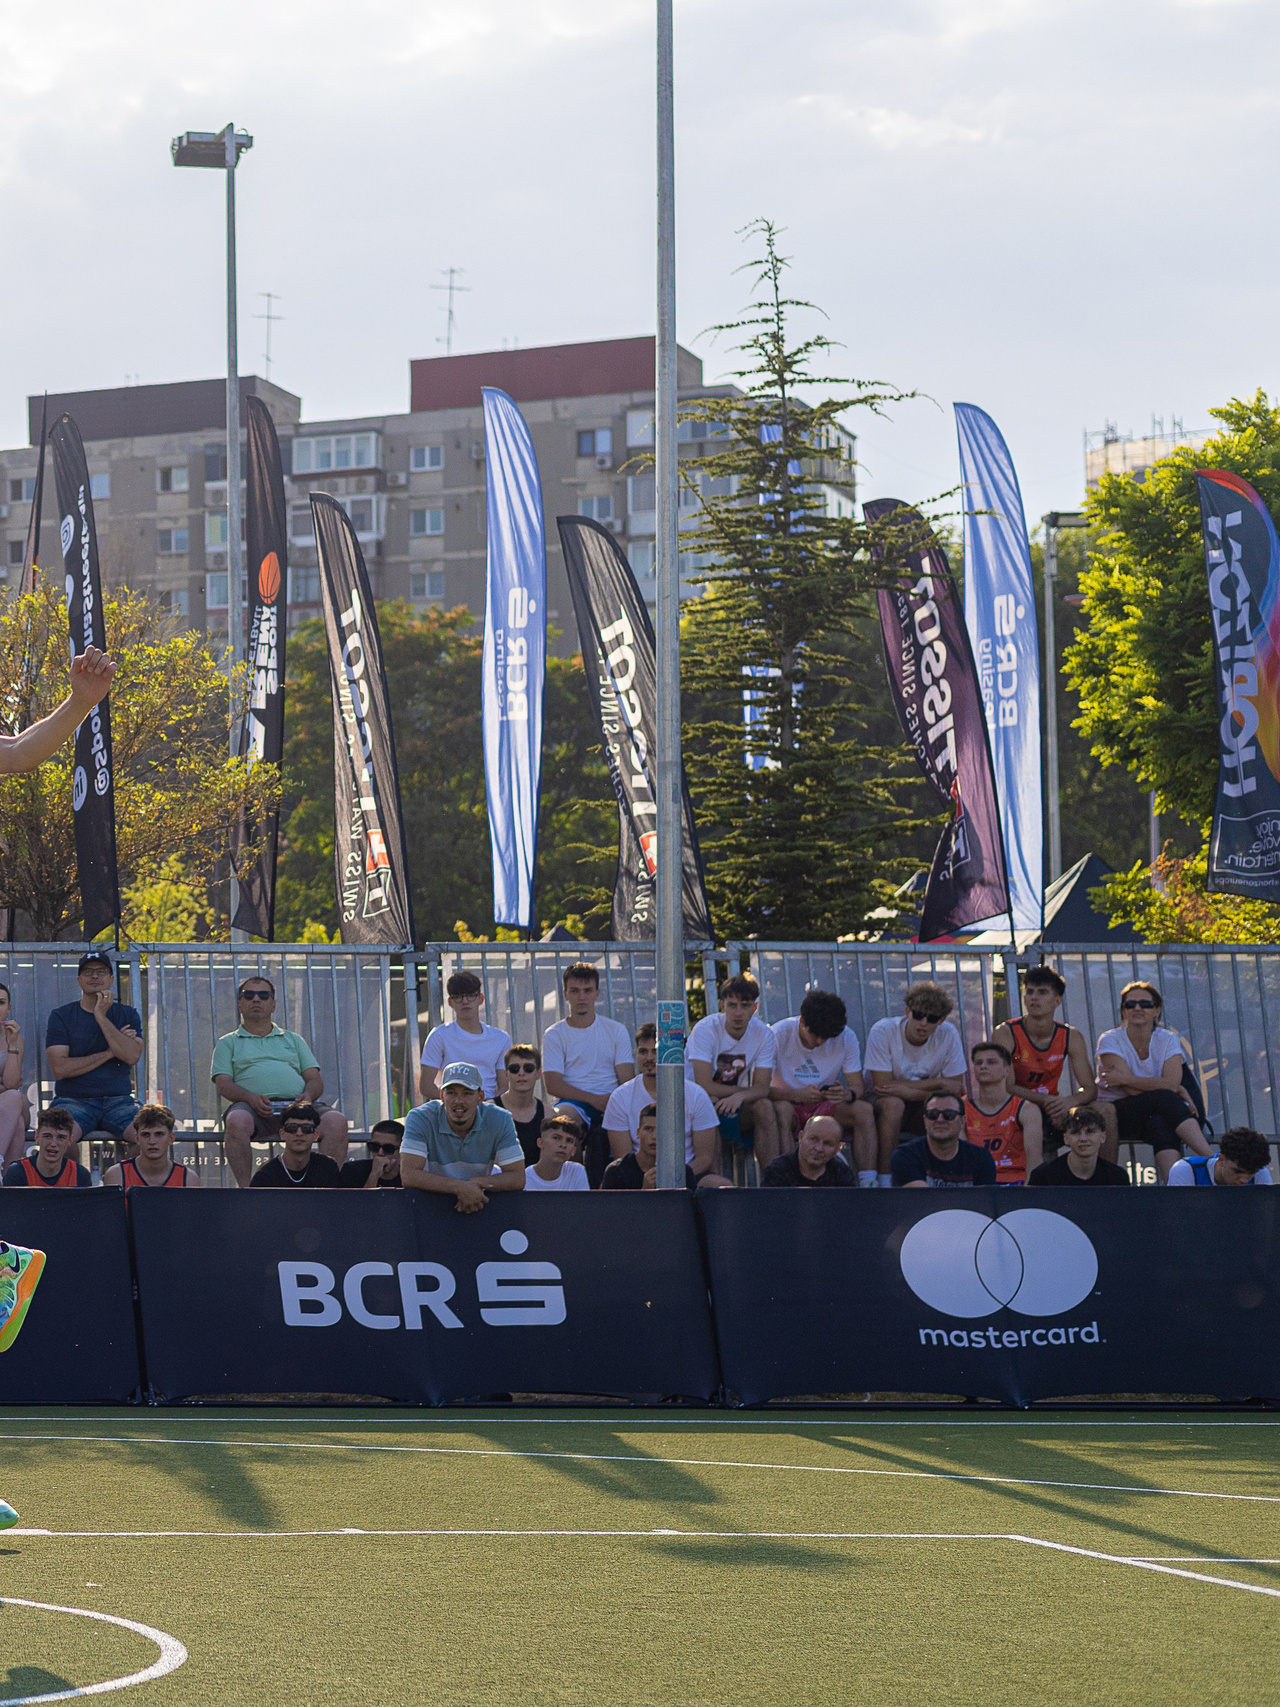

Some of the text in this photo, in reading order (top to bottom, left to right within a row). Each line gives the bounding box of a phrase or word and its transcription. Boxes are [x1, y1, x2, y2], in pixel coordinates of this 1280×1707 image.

[449, 1066, 470, 1076] NYC
[1027, 1071, 1044, 1083] 11
[982, 1138, 1002, 1151] 10
[278, 1261, 464, 1330] BCR
[919, 1321, 1100, 1348] mastercard
